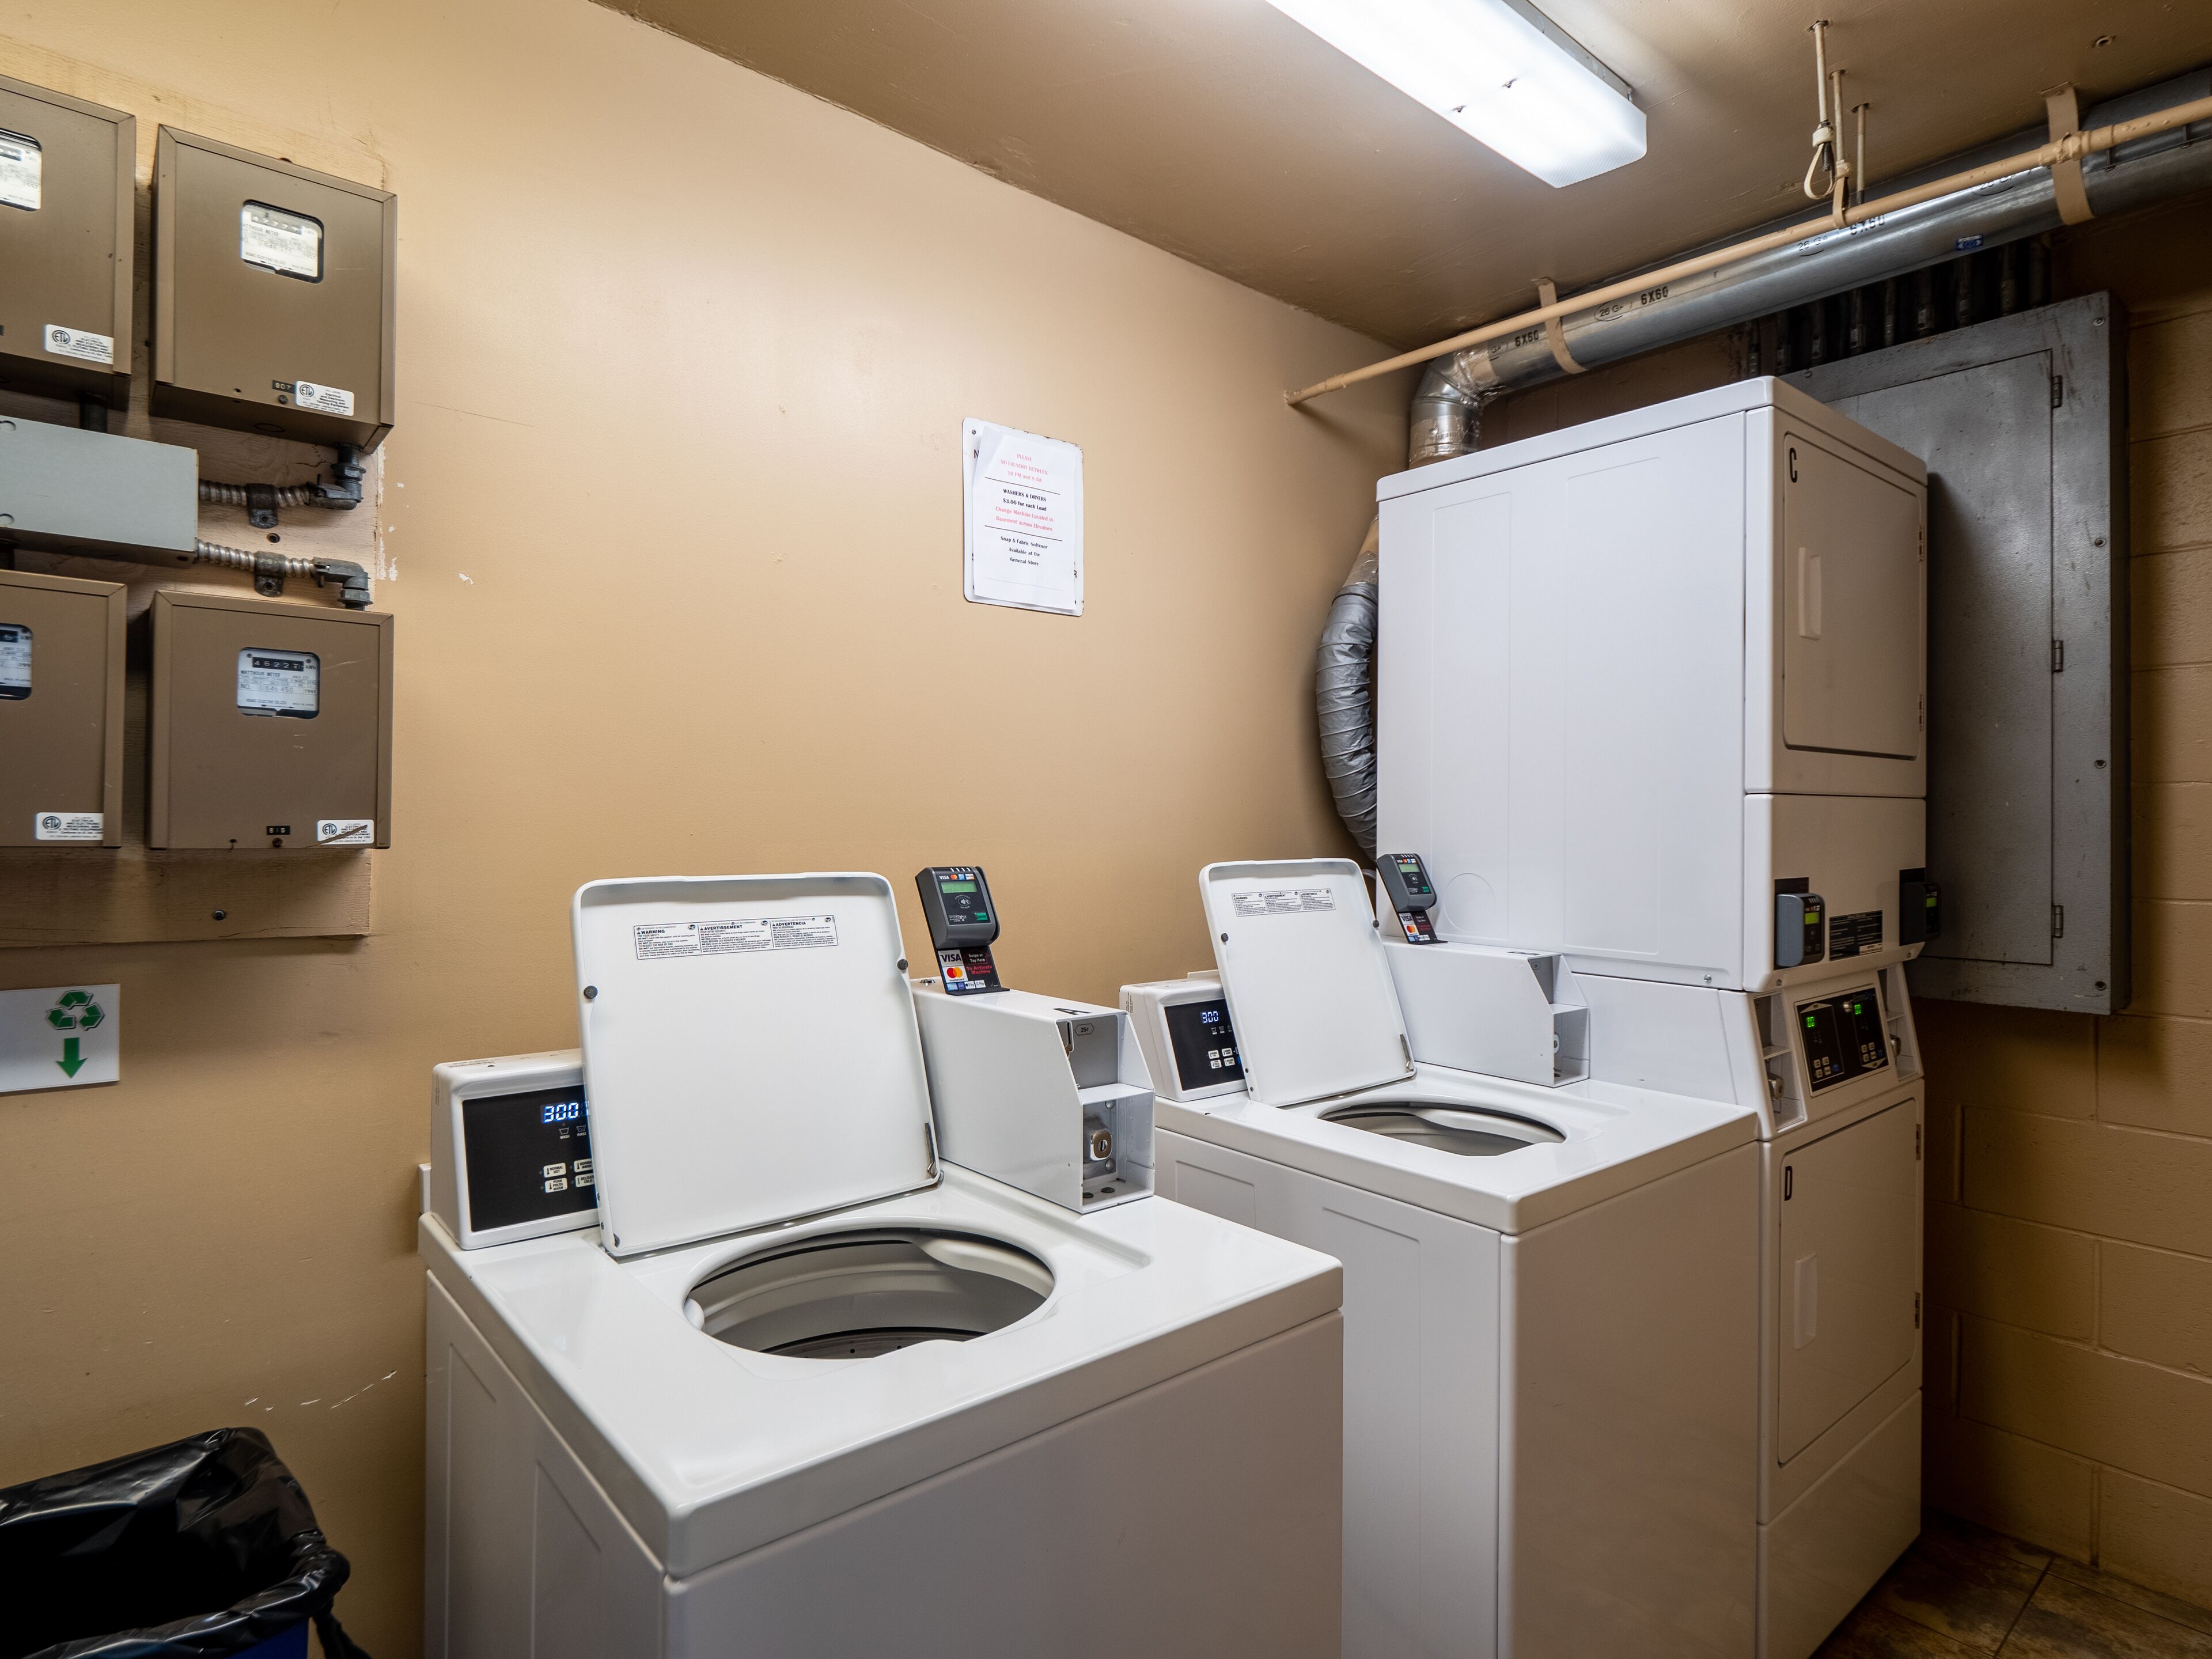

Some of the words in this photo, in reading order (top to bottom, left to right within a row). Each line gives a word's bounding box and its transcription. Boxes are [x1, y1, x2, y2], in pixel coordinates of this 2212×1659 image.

[1798, 241, 1810, 251] 26
[1599, 308, 1611, 317] 26
[1641, 286, 1669, 305] 6X60
[1515, 329, 1539, 347] 6X60
[1017, 453, 1032, 462] PLEASE
[1008, 460, 1028, 470] LAUNDRY
[1029, 466, 1048, 475] BETWEEN
[1789, 447, 1797, 483] C
[1003, 488, 1025, 497] WASHERS
[1030, 494, 1047, 502] DRYERS
[1014, 510, 1031, 518] Machine
[1032, 513, 1048, 521] Located
[996, 516, 1018, 524] Basement
[1033, 523, 1053, 531] Elevators
[1009, 547, 1027, 555] Available
[940, 953, 961, 963] VISA
[1202, 1011, 1219, 1023] 300
[543, 1102, 579, 1123] 300
[1784, 1165, 1793, 1201] D
